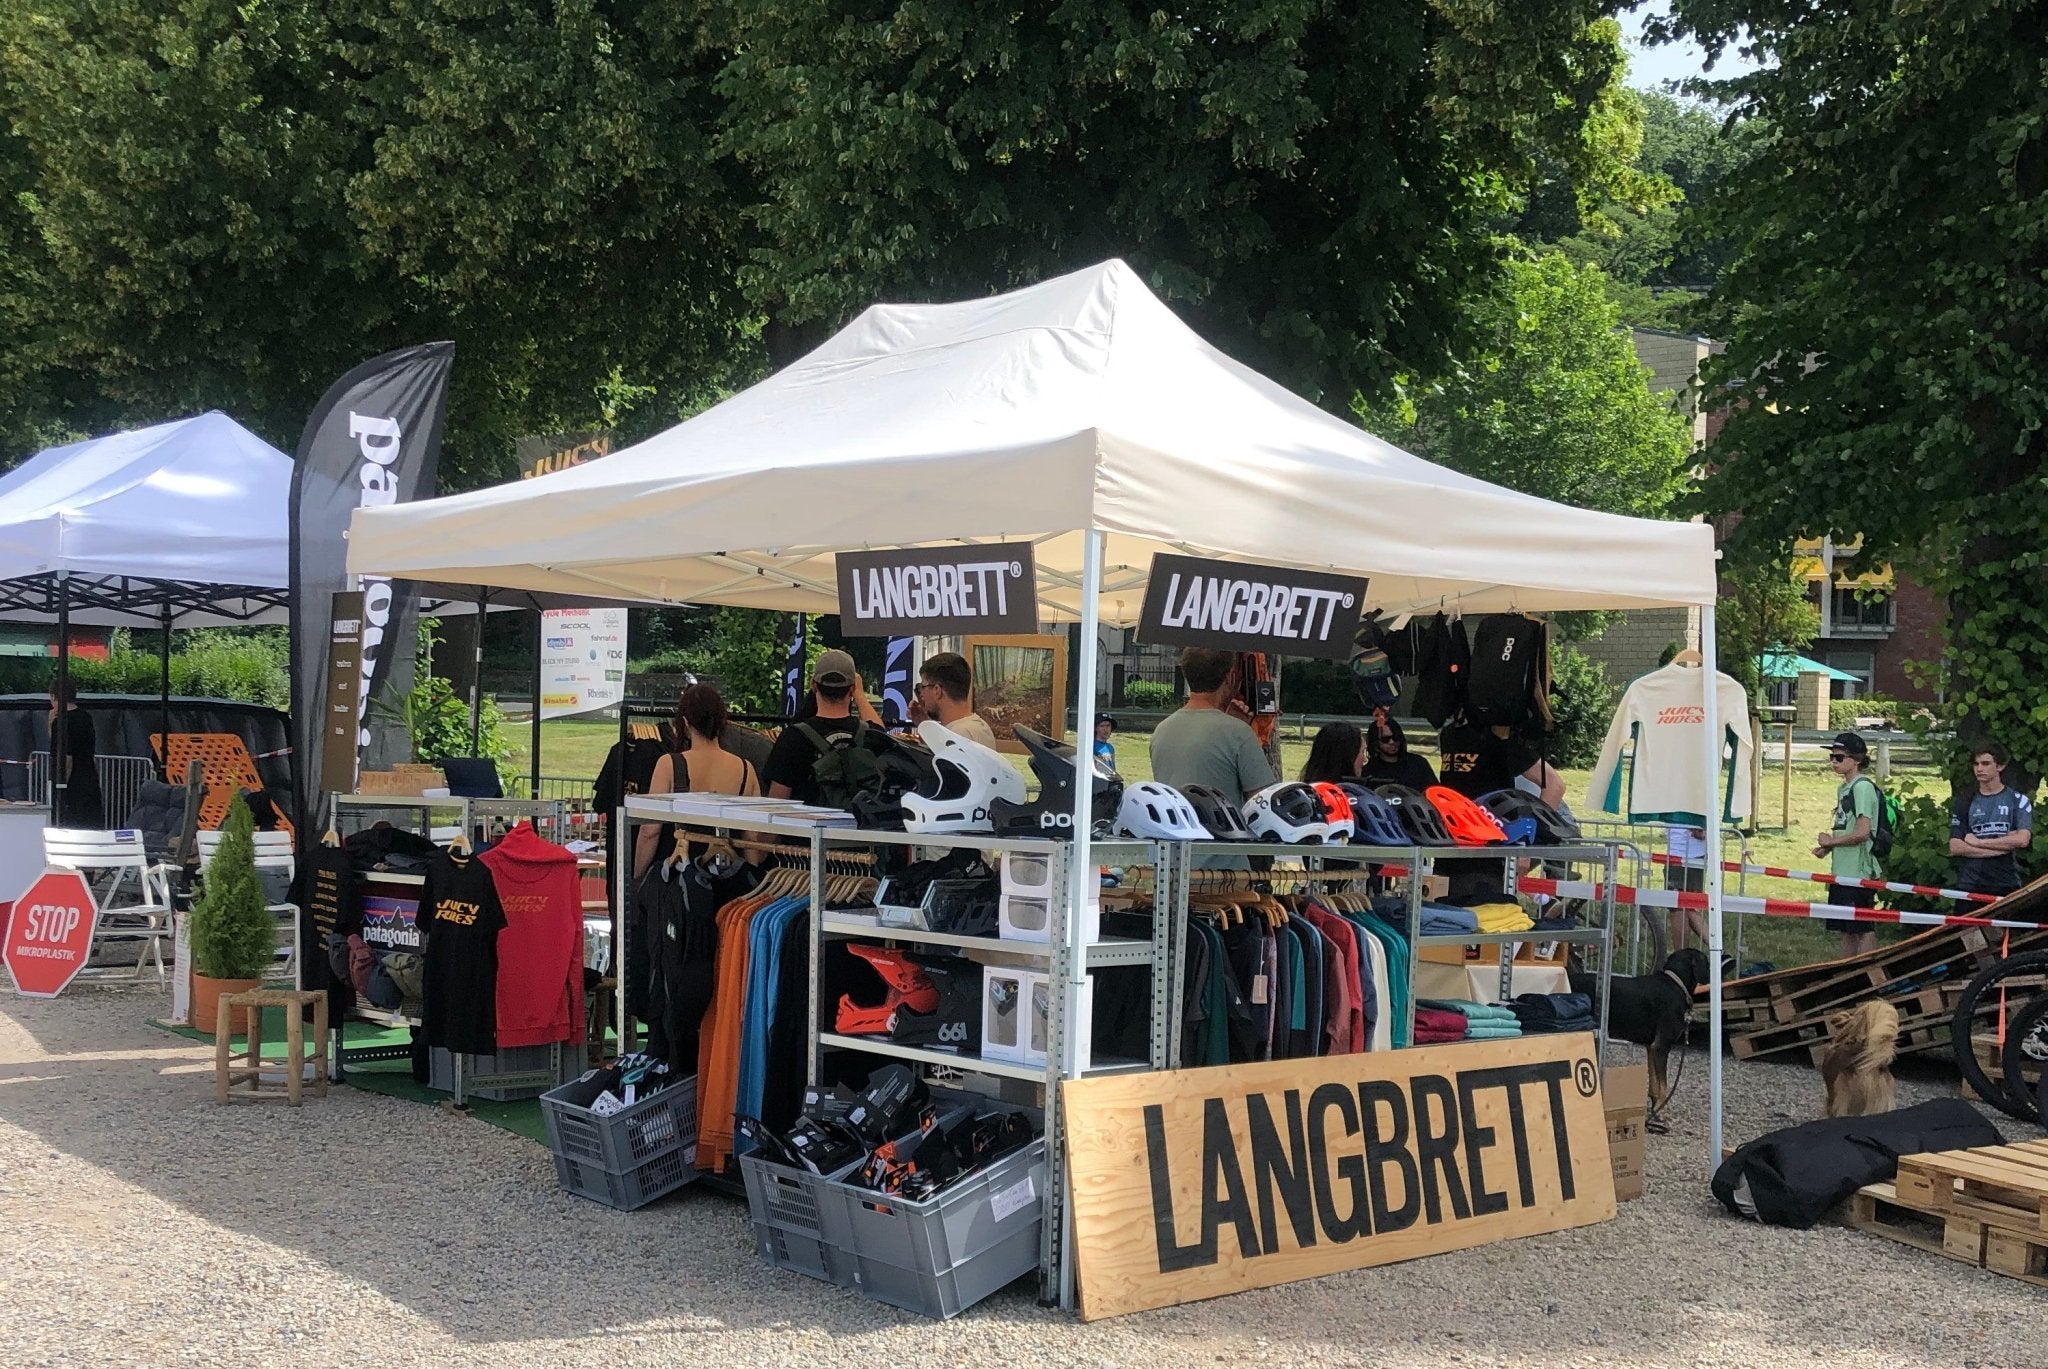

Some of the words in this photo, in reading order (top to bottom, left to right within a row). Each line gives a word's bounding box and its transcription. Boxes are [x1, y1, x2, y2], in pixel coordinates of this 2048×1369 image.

[1040, 810, 1076, 829] po
[25, 904, 80, 944] STOP
[16, 945, 76, 961] MIKROPLASTIK
[938, 1021, 968, 1042] 661
